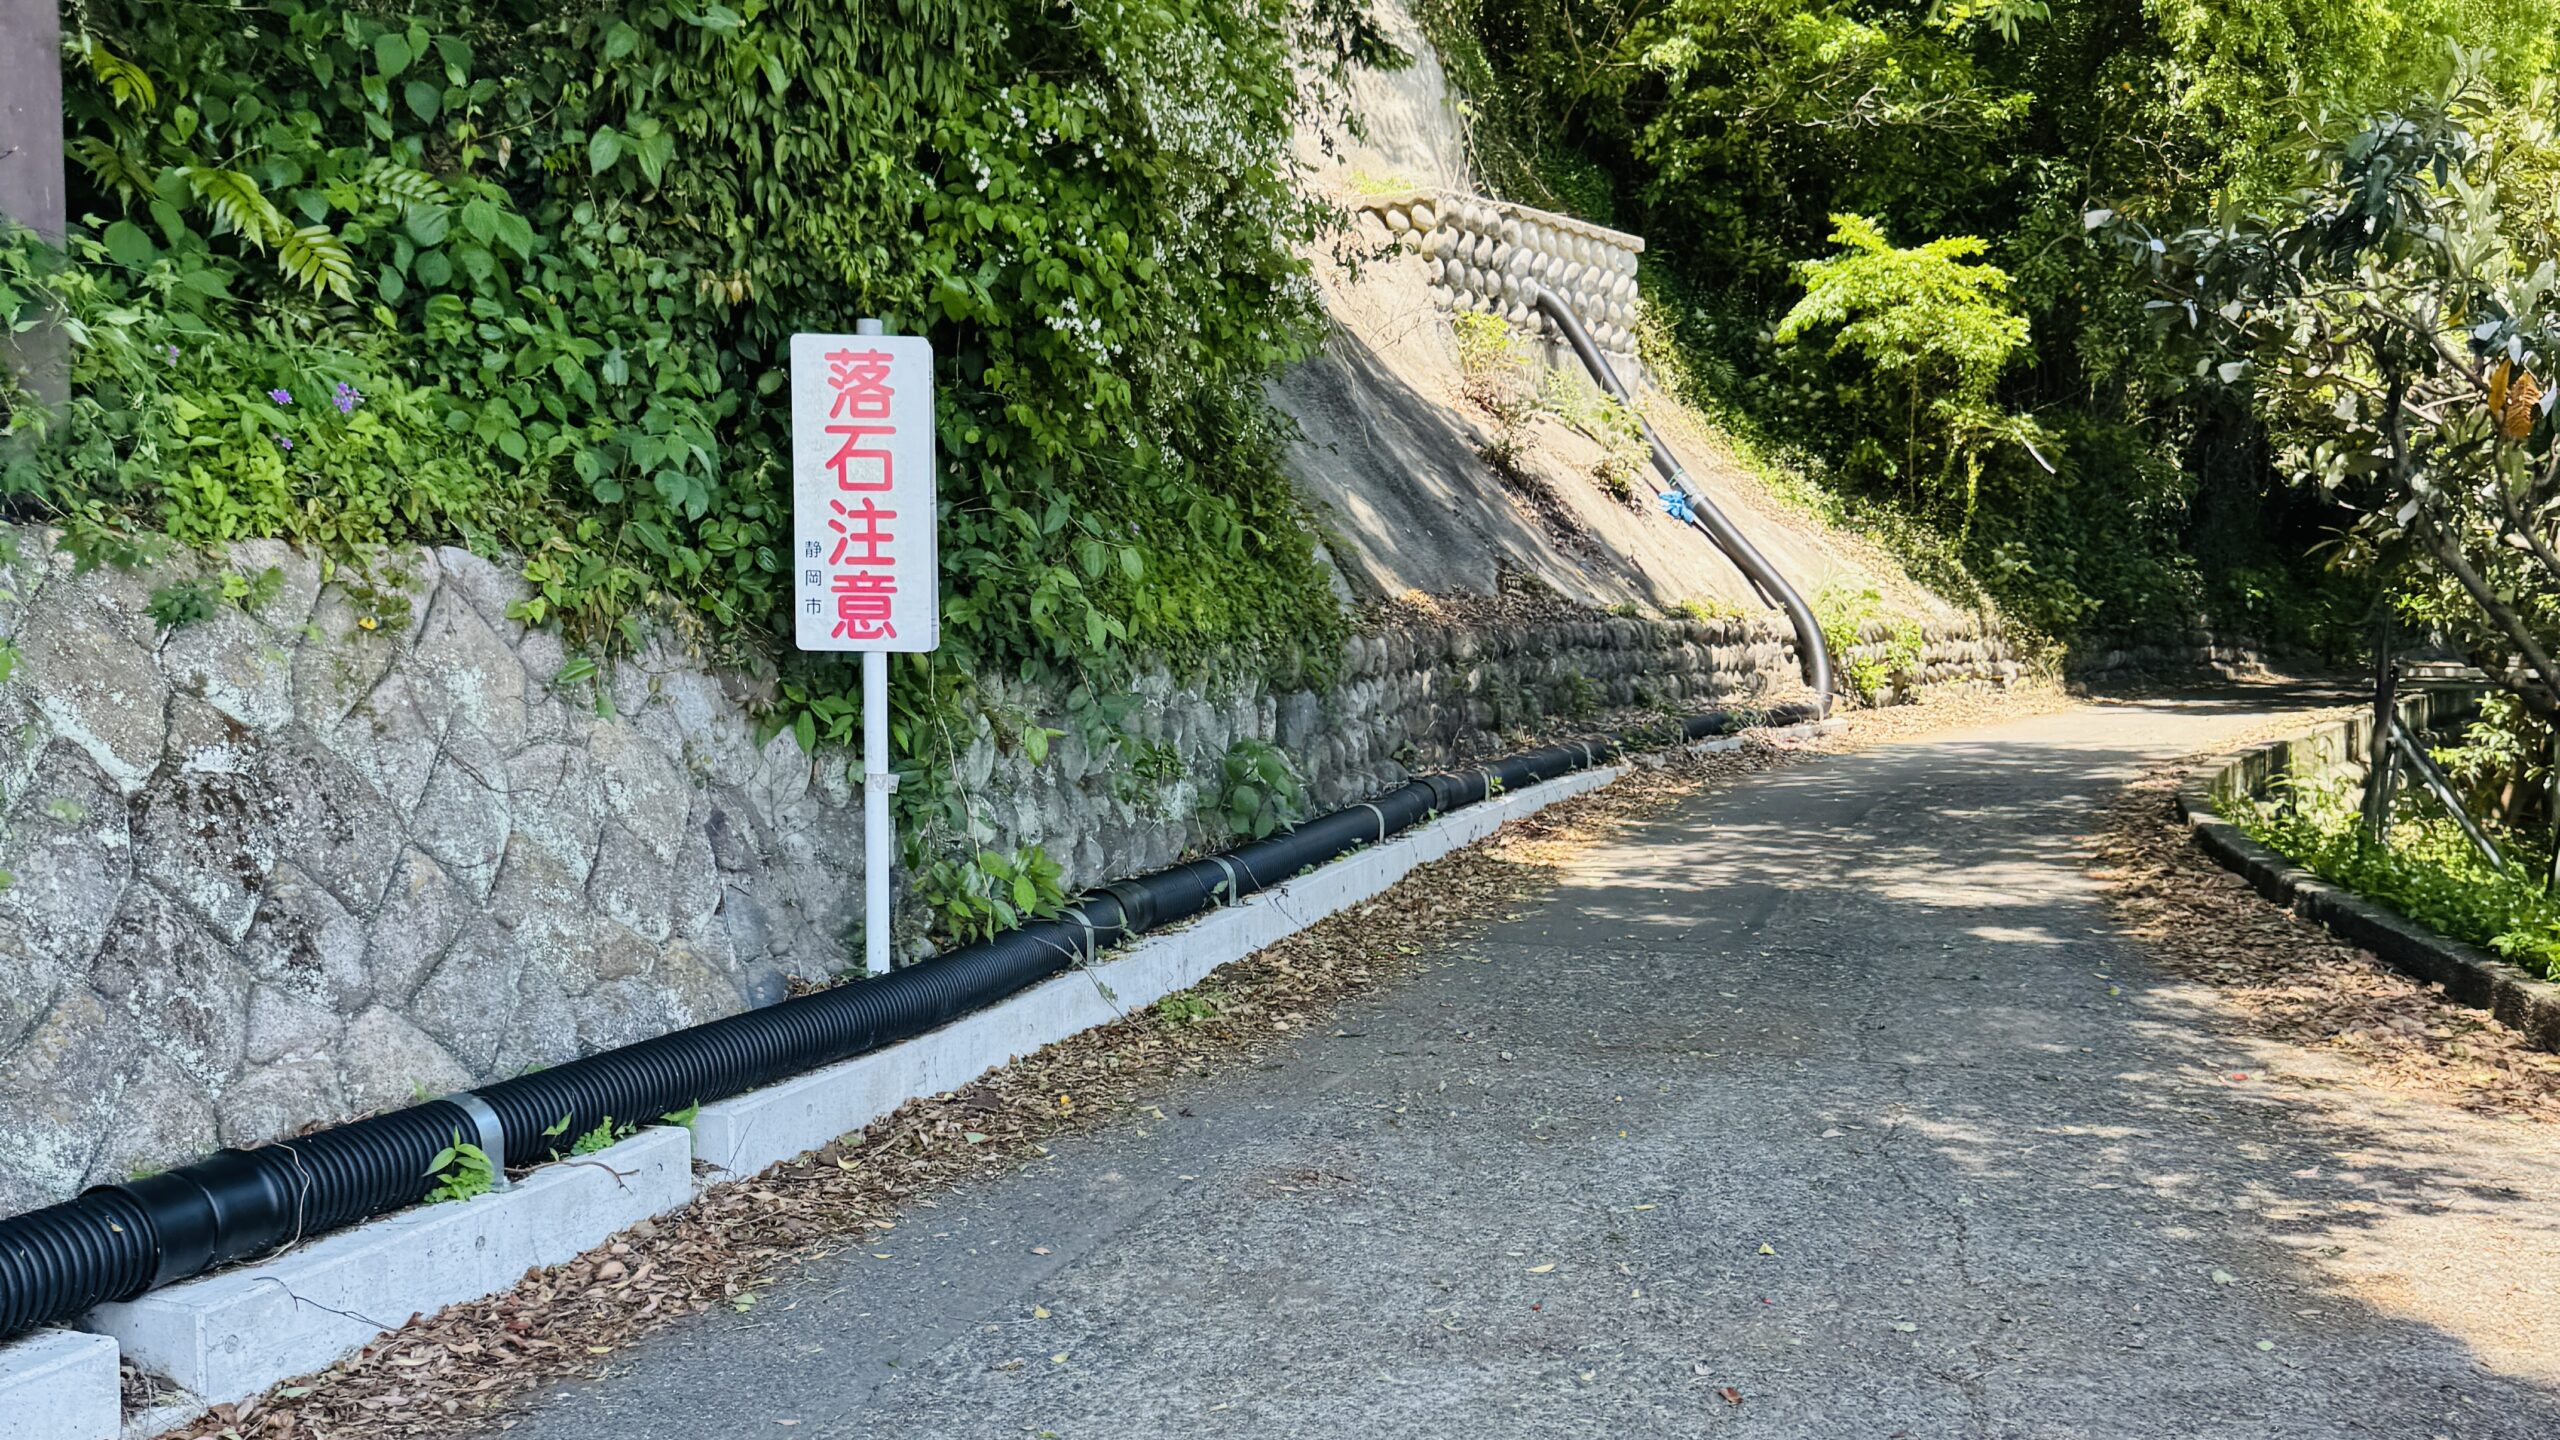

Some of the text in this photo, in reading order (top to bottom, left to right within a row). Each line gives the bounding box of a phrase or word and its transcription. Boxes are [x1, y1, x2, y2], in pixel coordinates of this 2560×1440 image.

[805, 540, 822, 615] 静岡市
[824, 348, 897, 639] 落石注意
